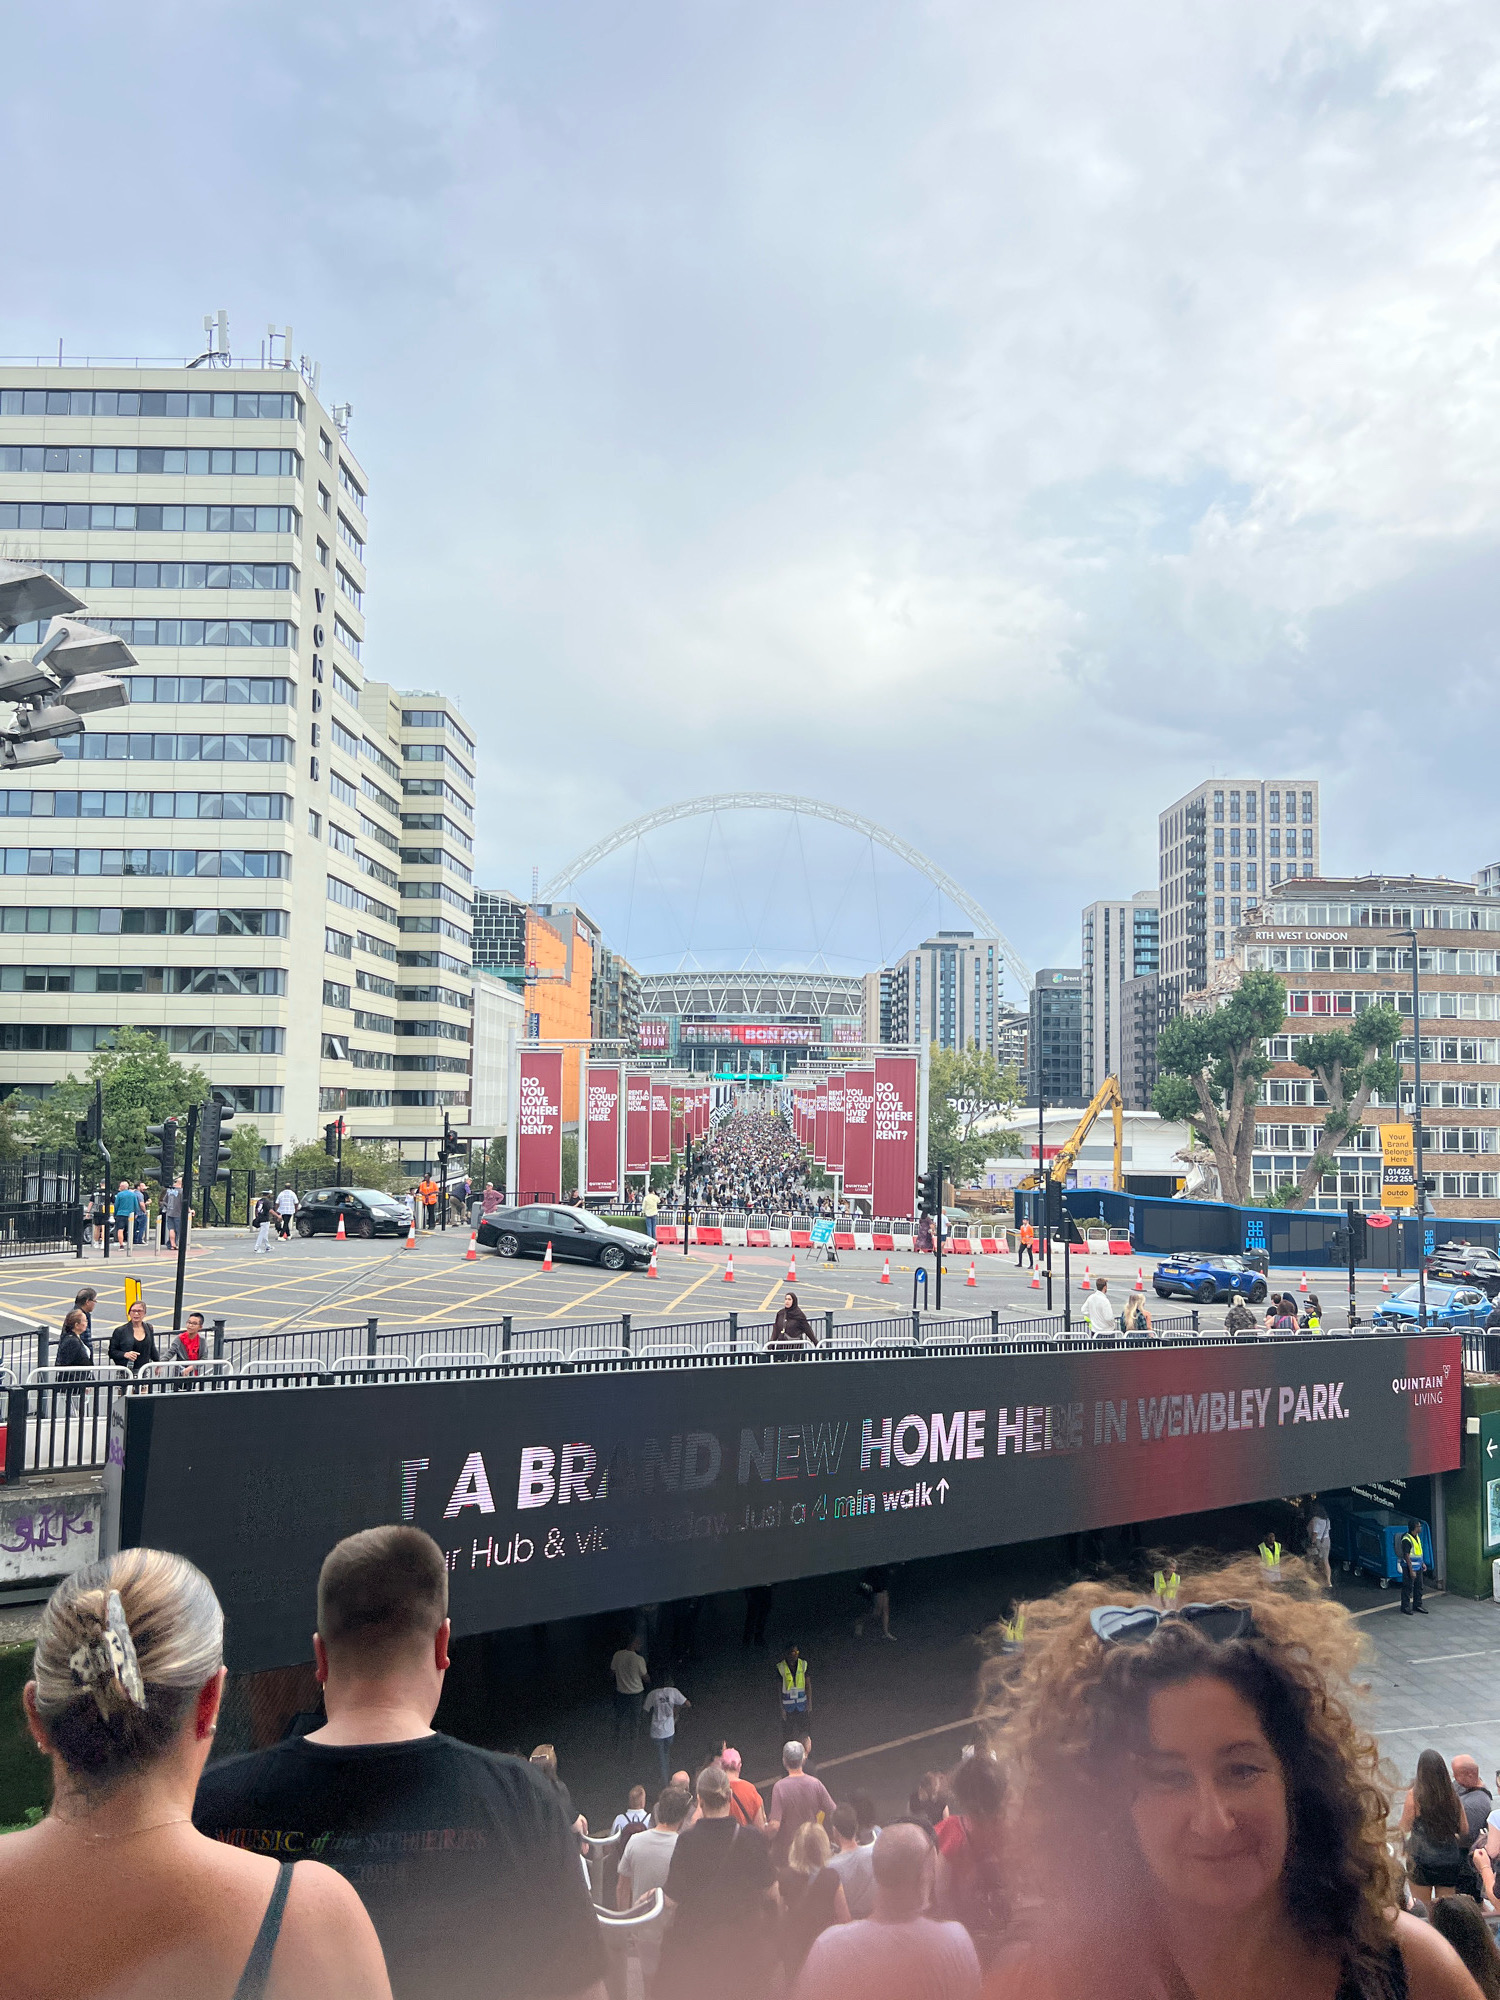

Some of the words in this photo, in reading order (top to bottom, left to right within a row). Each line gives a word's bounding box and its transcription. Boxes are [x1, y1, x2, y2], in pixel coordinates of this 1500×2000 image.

[310, 588, 326, 782] VONDER
[1255, 931, 1274, 940] RTH
[1276, 931, 1303, 940] WEST
[1305, 932, 1348, 941] LONDON
[639, 1025, 667, 1035] MBLEY
[745, 1029, 778, 1040] BON
[780, 1030, 813, 1040] JOVI
[640, 1037, 665, 1047] DIUM
[521, 1077, 539, 1087] DO
[876, 1082, 894, 1092] DO
[521, 1086, 545, 1096] YOU
[521, 1096, 549, 1106] LOVE
[589, 1093, 618, 1101] COULD
[876, 1092, 900, 1102] YOU
[589, 1100, 596, 1108] IF
[596, 1100, 614, 1108] YOU
[876, 1101, 903, 1111] LOVE
[521, 1106, 559, 1116] WHERE
[588, 1107, 611, 1115] LIVED
[846, 1109, 868, 1117] LIVED
[875, 1111, 913, 1121] WHERE
[521, 1115, 545, 1125] YOU
[588, 1114, 611, 1122] HERE.
[846, 1116, 868, 1124] HERE.
[520, 1125, 553, 1135] RENT?
[875, 1121, 899, 1131] YOU
[875, 1130, 908, 1140] RENT?
[1391, 1375, 1443, 1392] QUINTAIN
[1414, 1391, 1443, 1406] LIVING
[443, 1452, 495, 1519] A
[737, 1421, 848, 1485] NEW
[860, 1409, 986, 1471] HOME
[997, 1403, 1083, 1456] HERE
[1094, 1400, 1128, 1446] IN
[1139, 1387, 1271, 1441] WEMBLEY
[1278, 1382, 1349, 1426] PARK.
[1351, 1485, 1373, 1500] Wembley
[1373, 1493, 1395, 1508] Stadium
[1377, 1483, 1401, 1500] Wembley
[471, 1527, 535, 1569] Hub
[544, 1527, 566, 1559] &
[790, 1502, 807, 1525] a
[813, 1493, 828, 1521] 4
[834, 1488, 876, 1519] min
[882, 1480, 933, 1513] walk
